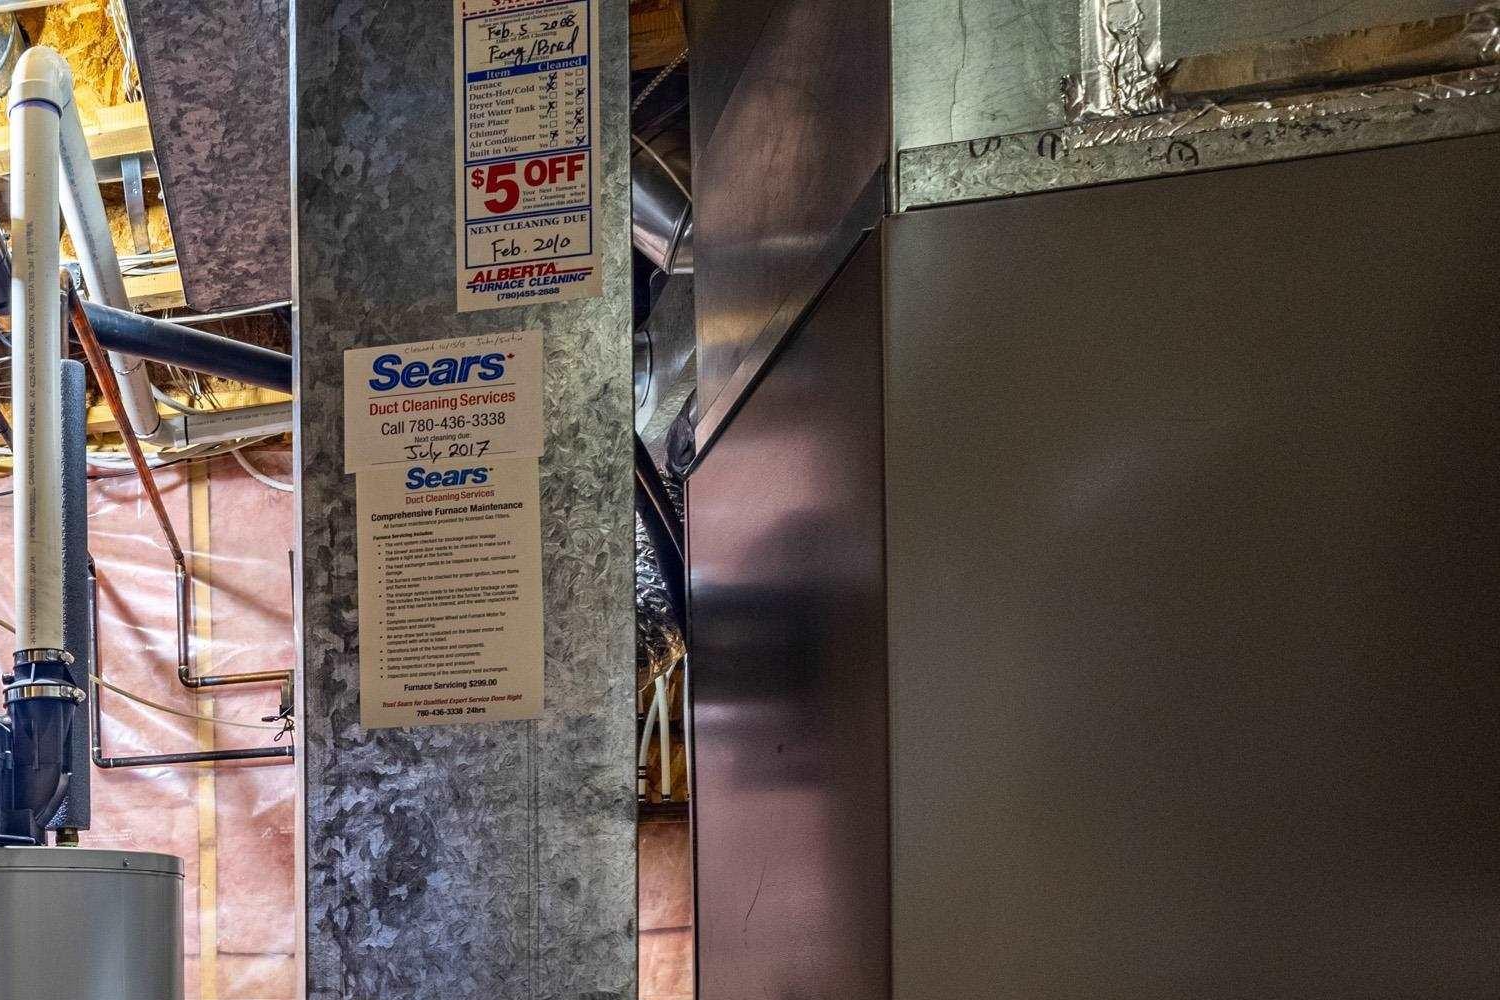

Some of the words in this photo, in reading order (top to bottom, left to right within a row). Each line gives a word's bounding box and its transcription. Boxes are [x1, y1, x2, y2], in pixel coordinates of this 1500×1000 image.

[488, 24, 513, 40] Feb.
[516, 24, 527, 36] 5
[540, 13, 577, 30] 2008
[486, 69, 510, 79] Item
[538, 58, 582, 71] Cleaned
[469, 81, 502, 91] Furnace
[469, 85, 535, 101] Ducts-Hot/Cold
[469, 102, 493, 111] Dryer
[496, 98, 514, 106] Vent
[470, 112, 485, 120] Hot
[487, 108, 512, 117] Water
[515, 105, 536, 114] Tank
[487, 119, 509, 127] Place
[469, 128, 508, 139] Chimney
[470, 141, 481, 149] Air
[485, 135, 536, 147] Conditioner
[470, 149, 490, 158] Built
[493, 147, 500, 155] in
[504, 145, 519, 153] Vac
[471, 162, 520, 214] $5
[524, 154, 585, 187] OFF
[470, 224, 500, 235] NEXT
[503, 217, 559, 231] CLEANING
[563, 214, 587, 224] DUE
[491, 238, 528, 262] Feb.
[533, 234, 570, 253] 2010
[471, 262, 558, 284] ALBERTA
[471, 280, 524, 293] FURNACE
[529, 273, 585, 286] CLEANING
[369, 352, 506, 391] Sears
[369, 402, 399, 416] Duct
[402, 396, 458, 412] Cleaning
[460, 391, 516, 406] Services
[381, 422, 405, 436] Call
[409, 412, 505, 433] 780-436-3338
[414, 435, 429, 443] Next
[430, 433, 457, 443] cleaning
[457, 432, 472, 440] due:
[404, 442, 442, 463] July
[449, 440, 490, 458] 2017
[406, 467, 488, 490] Sears
[405, 496, 424, 504] Duct
[425, 493, 460, 503] Cleaning
[461, 489, 495, 499] Services
[371, 508, 433, 522] Comprehensive
[435, 505, 467, 516] Furnace
[470, 502, 523, 513] Maintenance
[404, 683, 432, 692] Furnace
[434, 681, 467, 690] Servicing
[468, 679, 497, 688] $299.00
[417, 709, 463, 717] 780-436-3338
